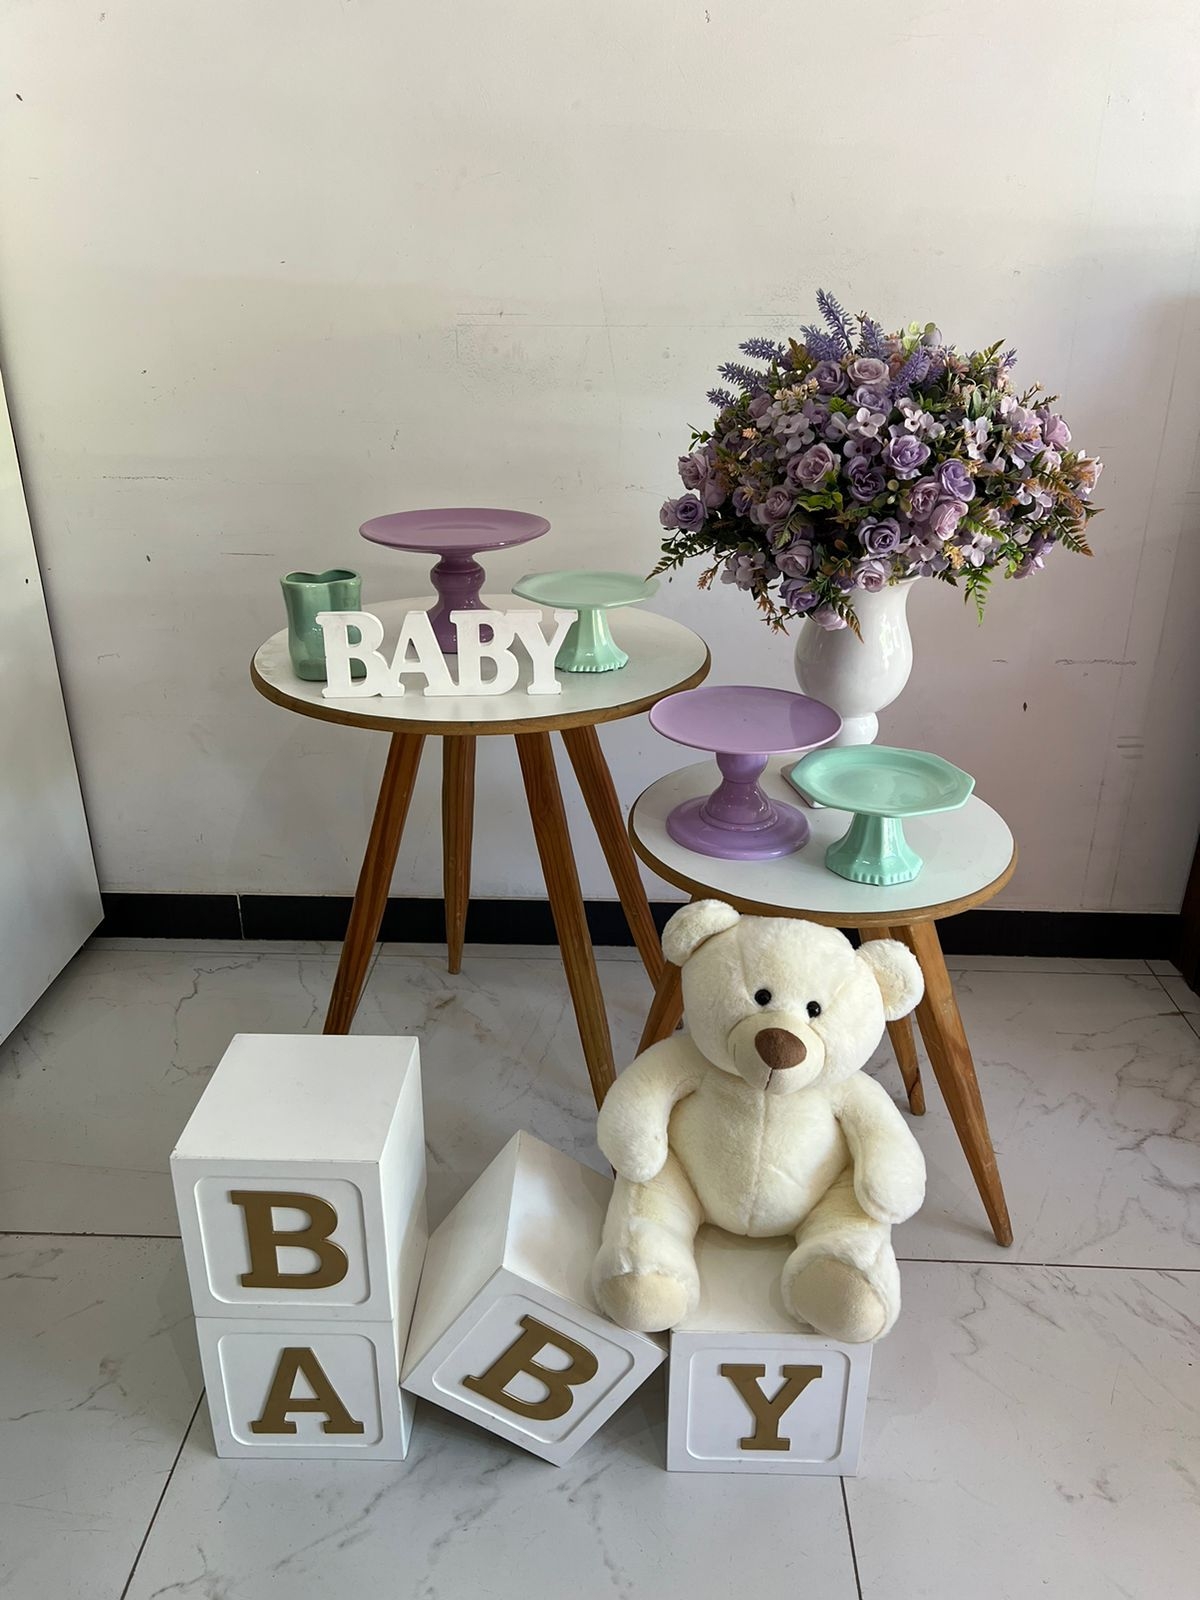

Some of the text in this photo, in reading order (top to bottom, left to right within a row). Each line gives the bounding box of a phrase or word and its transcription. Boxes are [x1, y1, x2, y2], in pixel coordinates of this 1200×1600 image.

[315, 609, 579, 698] BABY
[230, 1189, 349, 1290] B
[251, 1346, 364, 1434] A
[462, 1313, 599, 1422] B
[720, 1363, 823, 1451] Y
